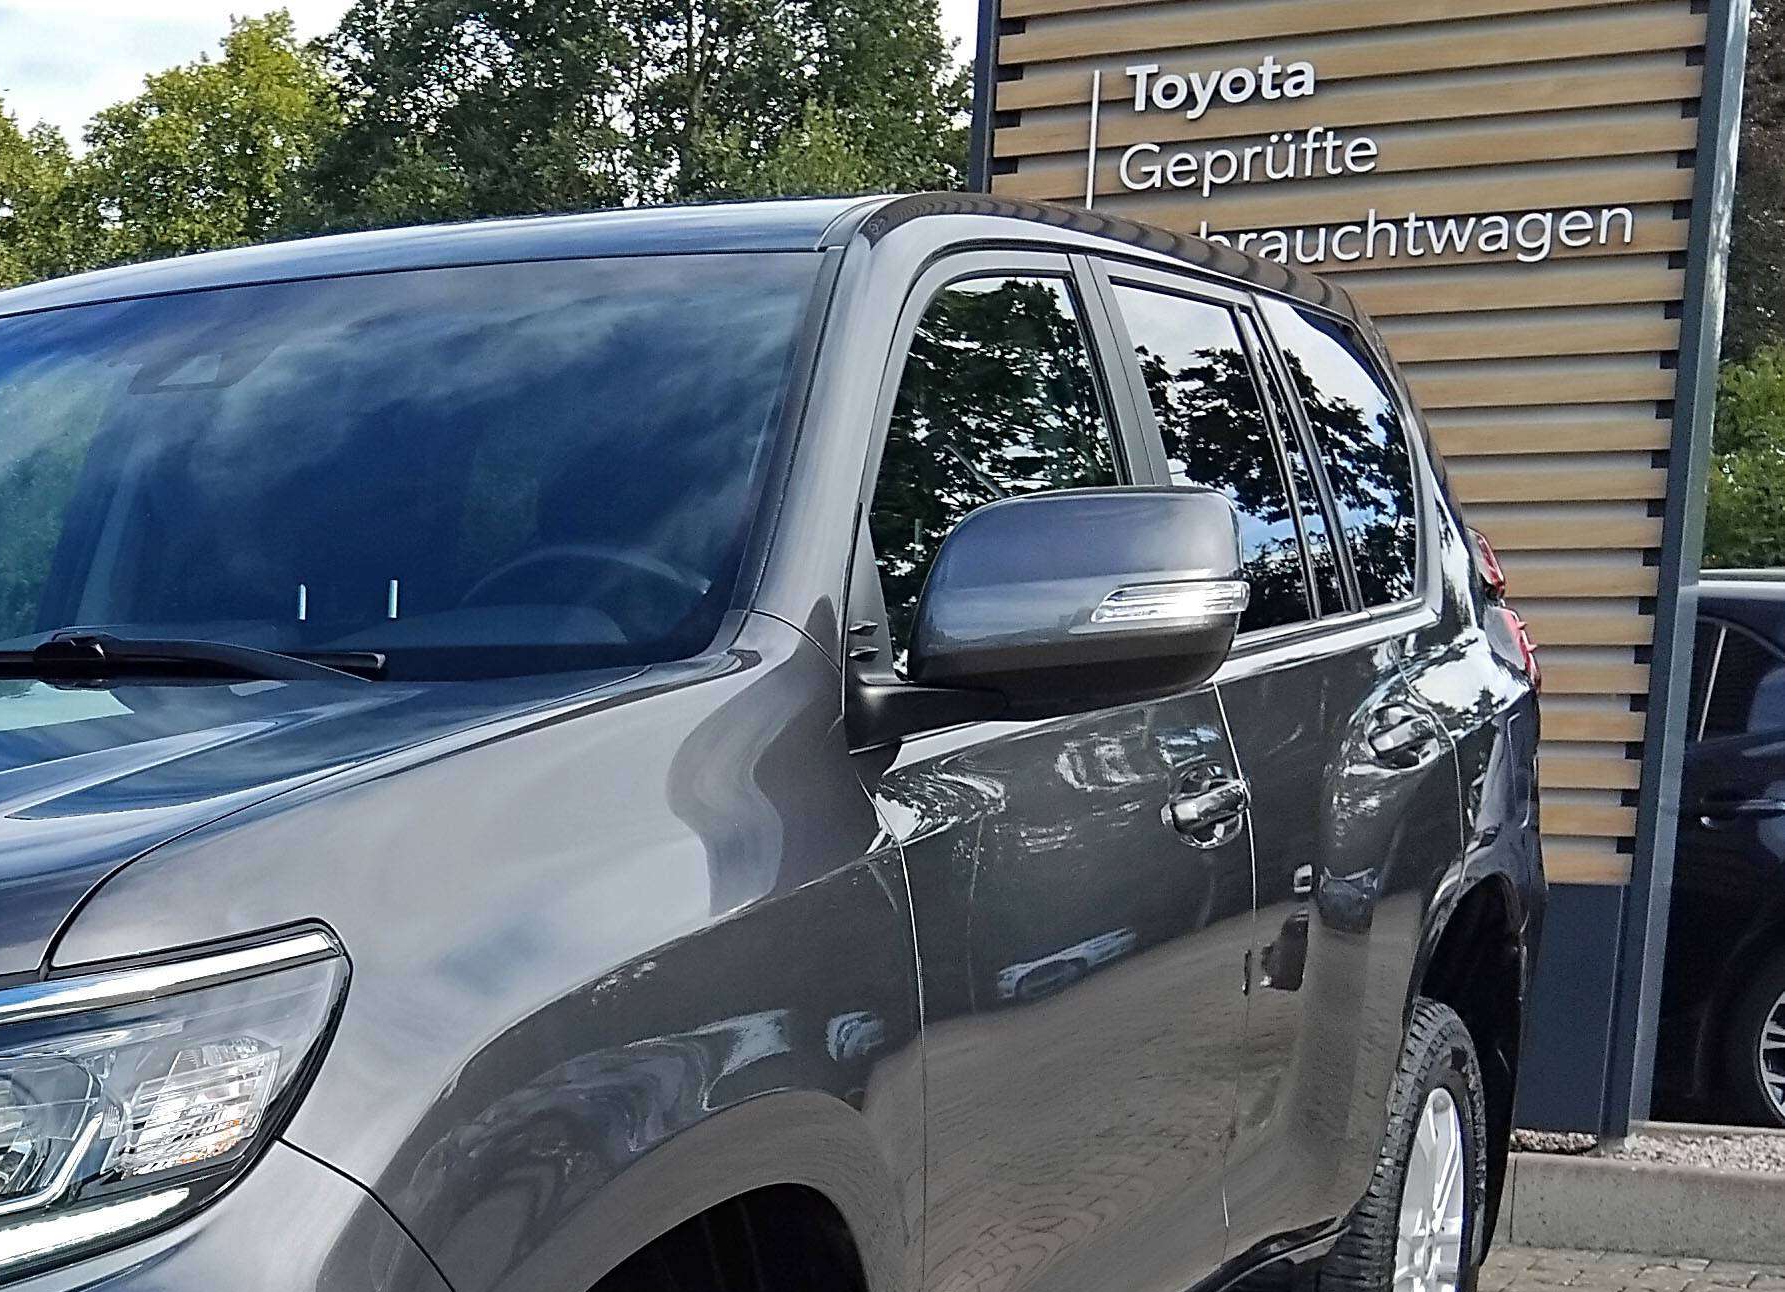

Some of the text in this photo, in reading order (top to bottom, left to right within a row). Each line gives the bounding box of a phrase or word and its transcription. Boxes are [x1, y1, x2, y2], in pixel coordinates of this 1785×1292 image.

[1125, 56, 1317, 120] Toyota
[1118, 127, 1379, 196] Geprüfte
[1199, 205, 1634, 263] brauchtwagen
